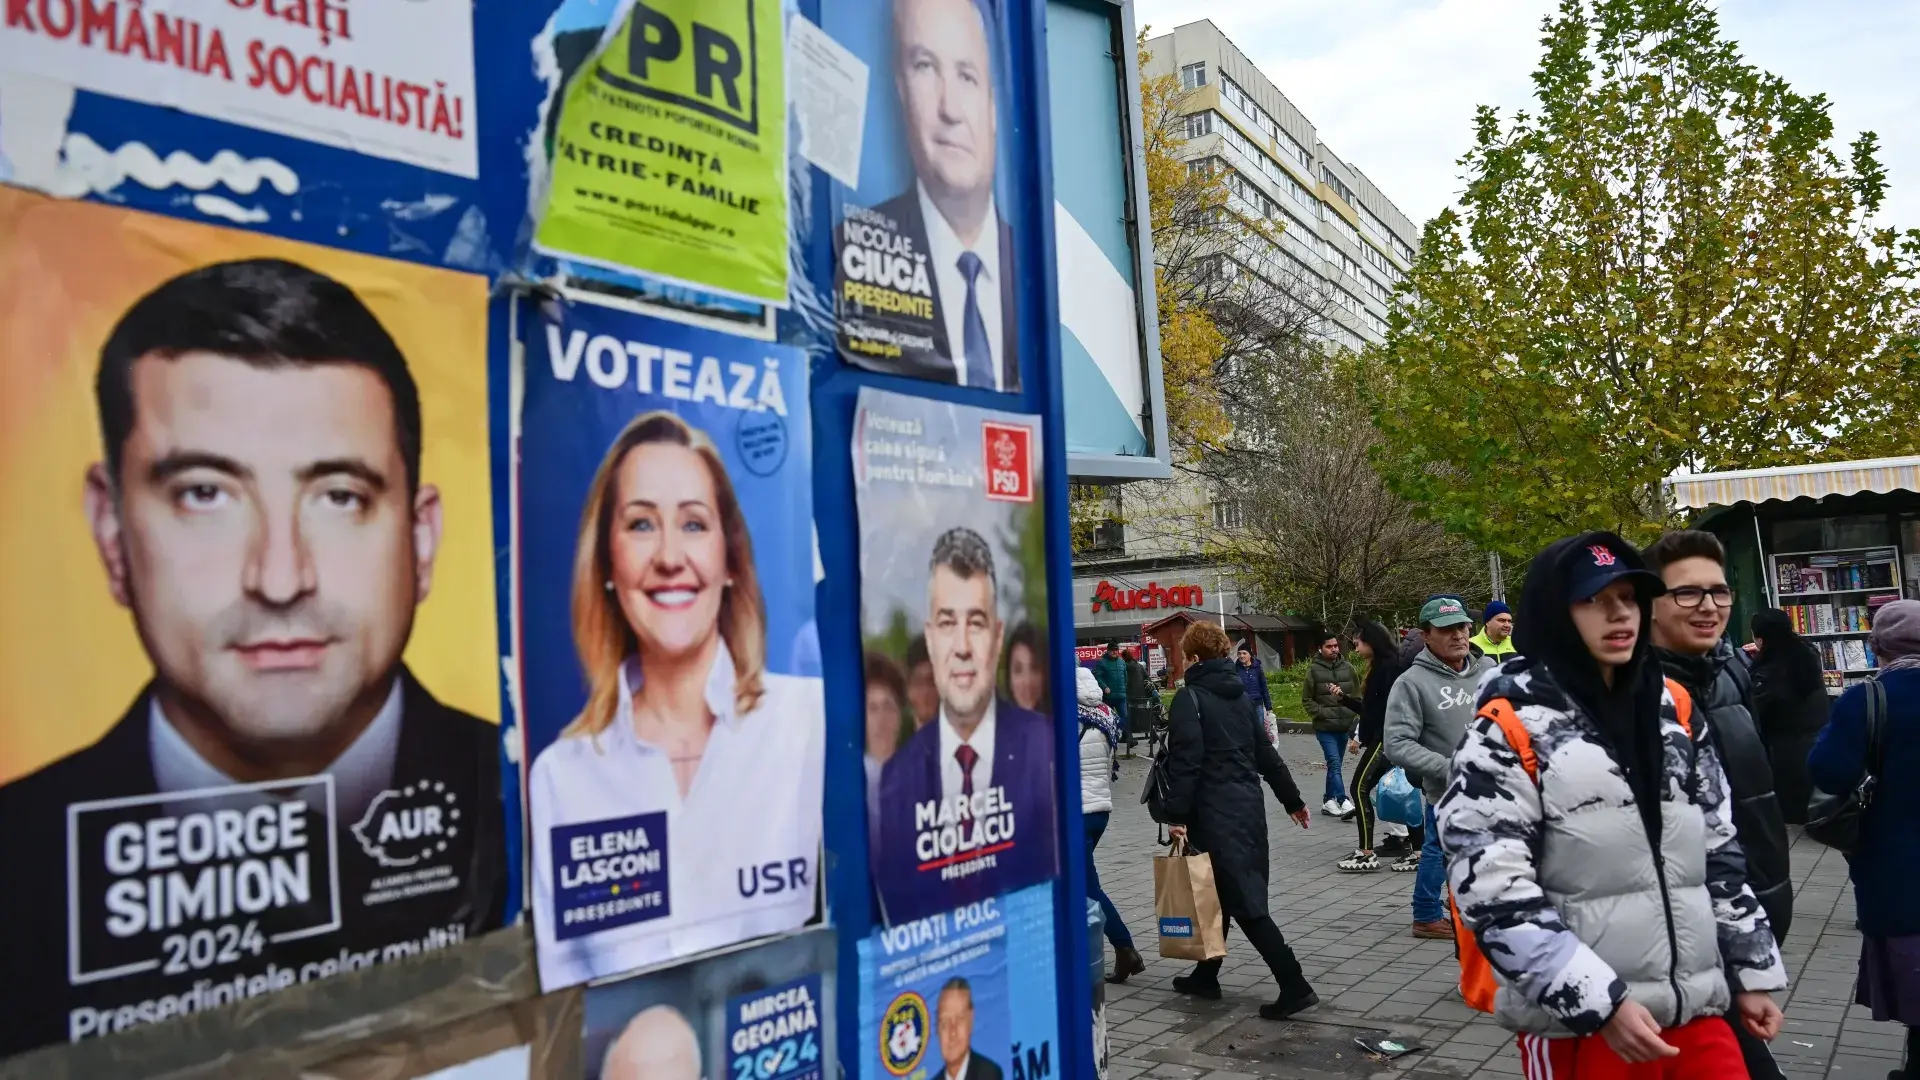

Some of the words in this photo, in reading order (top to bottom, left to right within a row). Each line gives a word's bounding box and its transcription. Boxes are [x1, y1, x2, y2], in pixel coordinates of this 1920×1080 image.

[4, 0, 233, 81] ROMÂNIA
[247, 40, 465, 139] SOCIALISTĂ!
[843, 220, 912, 258] NICOLAE
[842, 244, 932, 297] CIUCĂ
[844, 281, 934, 320] PREȘEDINTE
[546, 323, 788, 417] VOTEAZĂ
[993, 469, 1020, 493] PSD
[1091, 580, 1204, 613] Auchan
[378, 805, 444, 843] AUR
[915, 785, 1013, 831] MARCEL
[105, 800, 308, 875] GEORGE
[570, 827, 650, 861] ELENA
[915, 812, 1015, 862] CIOLACU
[560, 849, 661, 889] LASCONI
[737, 857, 809, 899] USR
[941, 854, 998, 881] PREȘEDINTE
[105, 852, 311, 937] SIMION
[562, 890, 663, 926] PREȘEDINTE
[162, 920, 268, 975] 2024
[880, 911, 948, 956] VOTAȚI
[740, 984, 811, 1024] MIRCEA
[732, 999, 818, 1054] GEOANĂ
